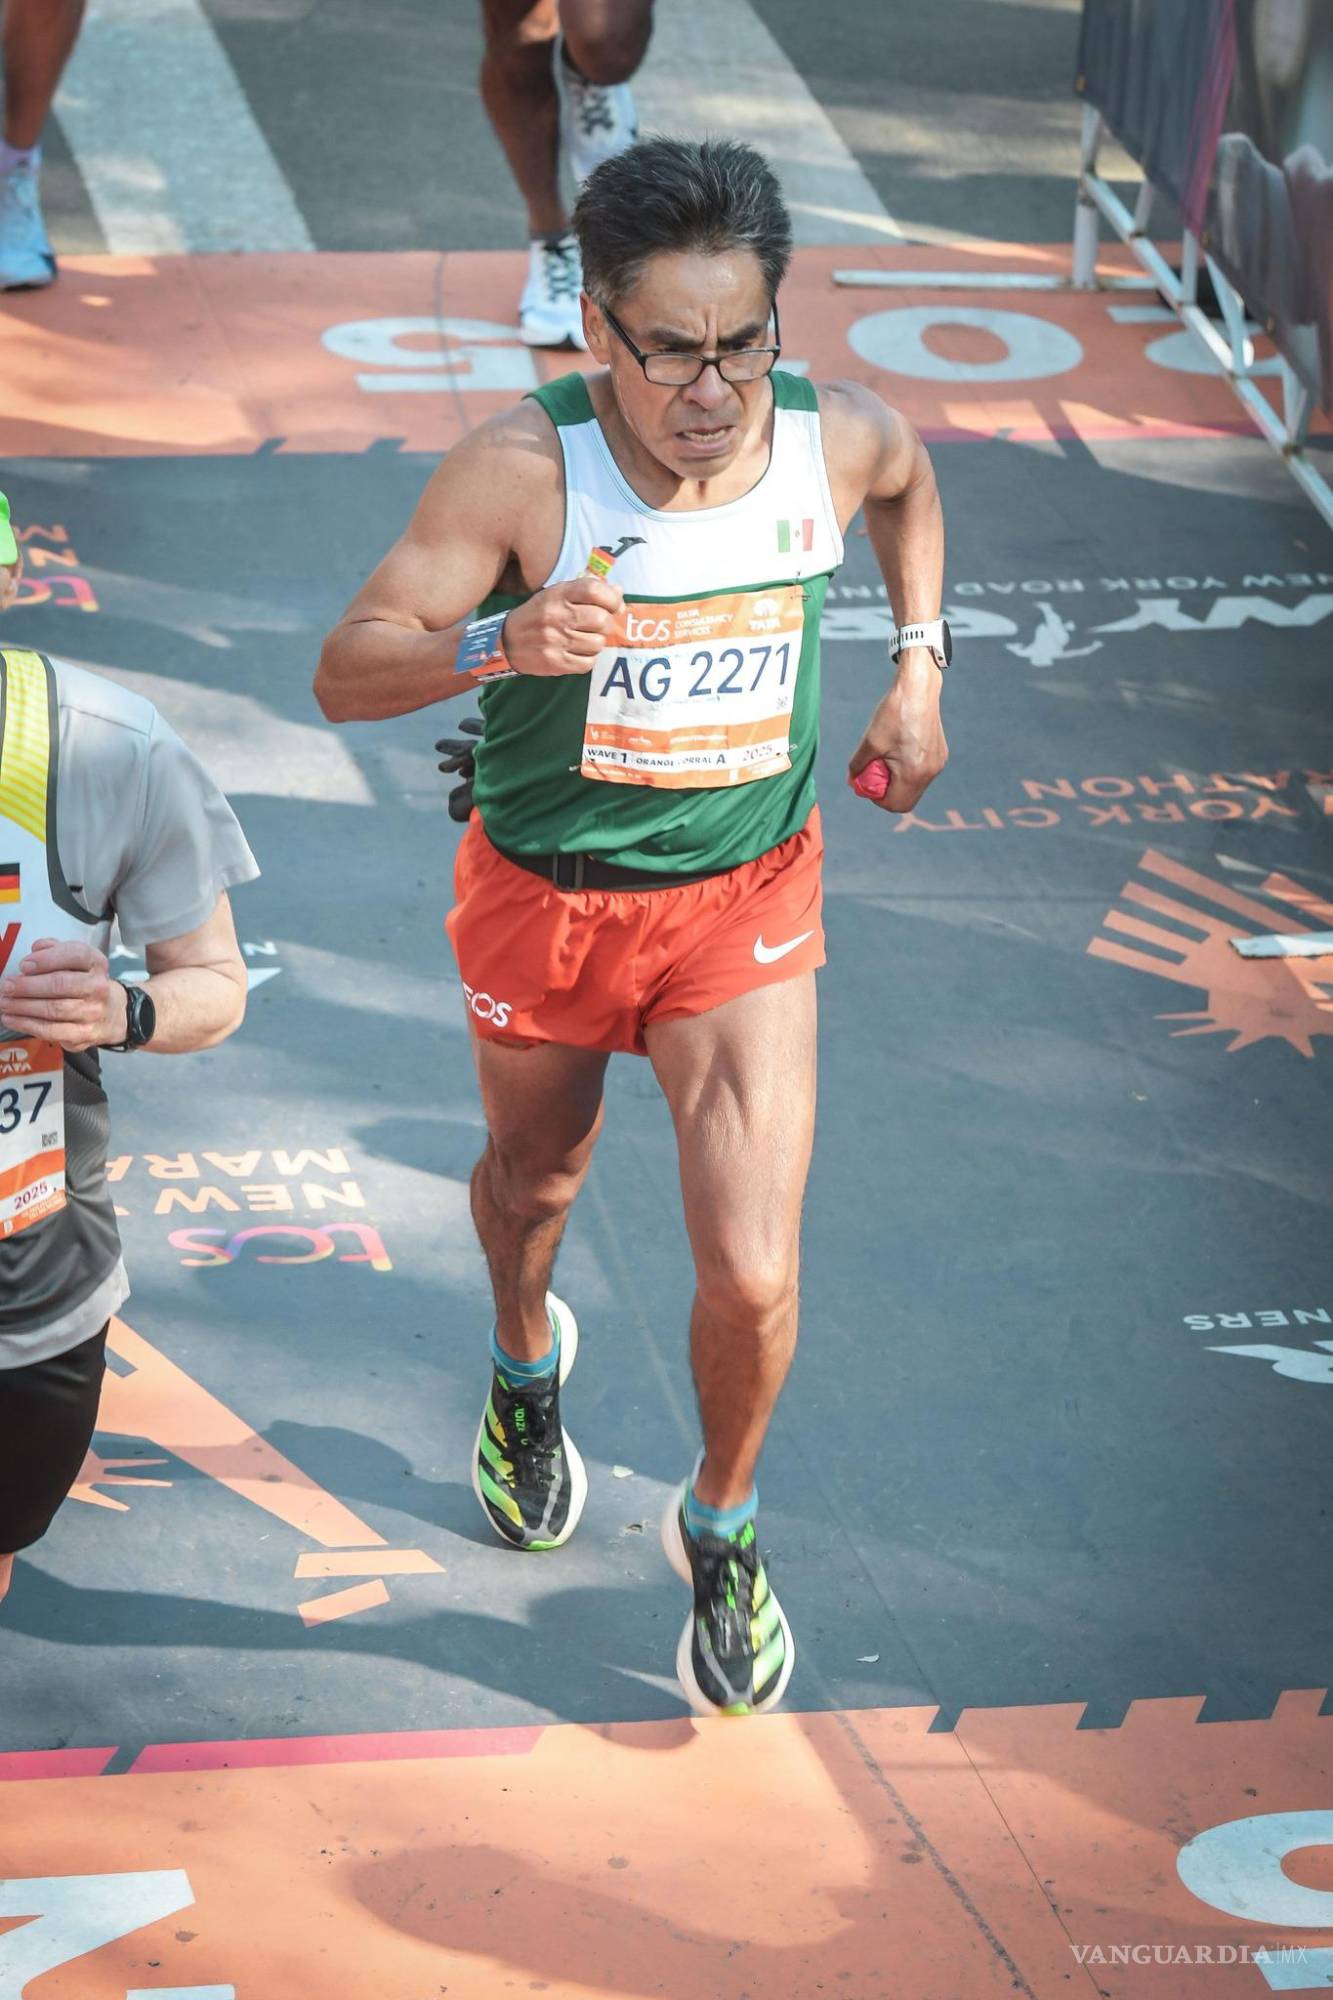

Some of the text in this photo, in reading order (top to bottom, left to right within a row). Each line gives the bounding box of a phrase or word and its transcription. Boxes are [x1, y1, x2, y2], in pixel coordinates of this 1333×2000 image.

[955, 578, 1084, 595] ROAD
[1100, 576, 1228, 591] YORK
[626, 613, 673, 642] tcs
[600, 642, 790, 702] AG 2271
[587, 748, 617, 760] WAVE
[620, 752, 628, 764] 1
[716, 754, 726, 765] A
[892, 795, 1298, 834] YORK CITY
[14, 1182, 48, 1210] 2025
[154, 1181, 366, 1215] NEW
